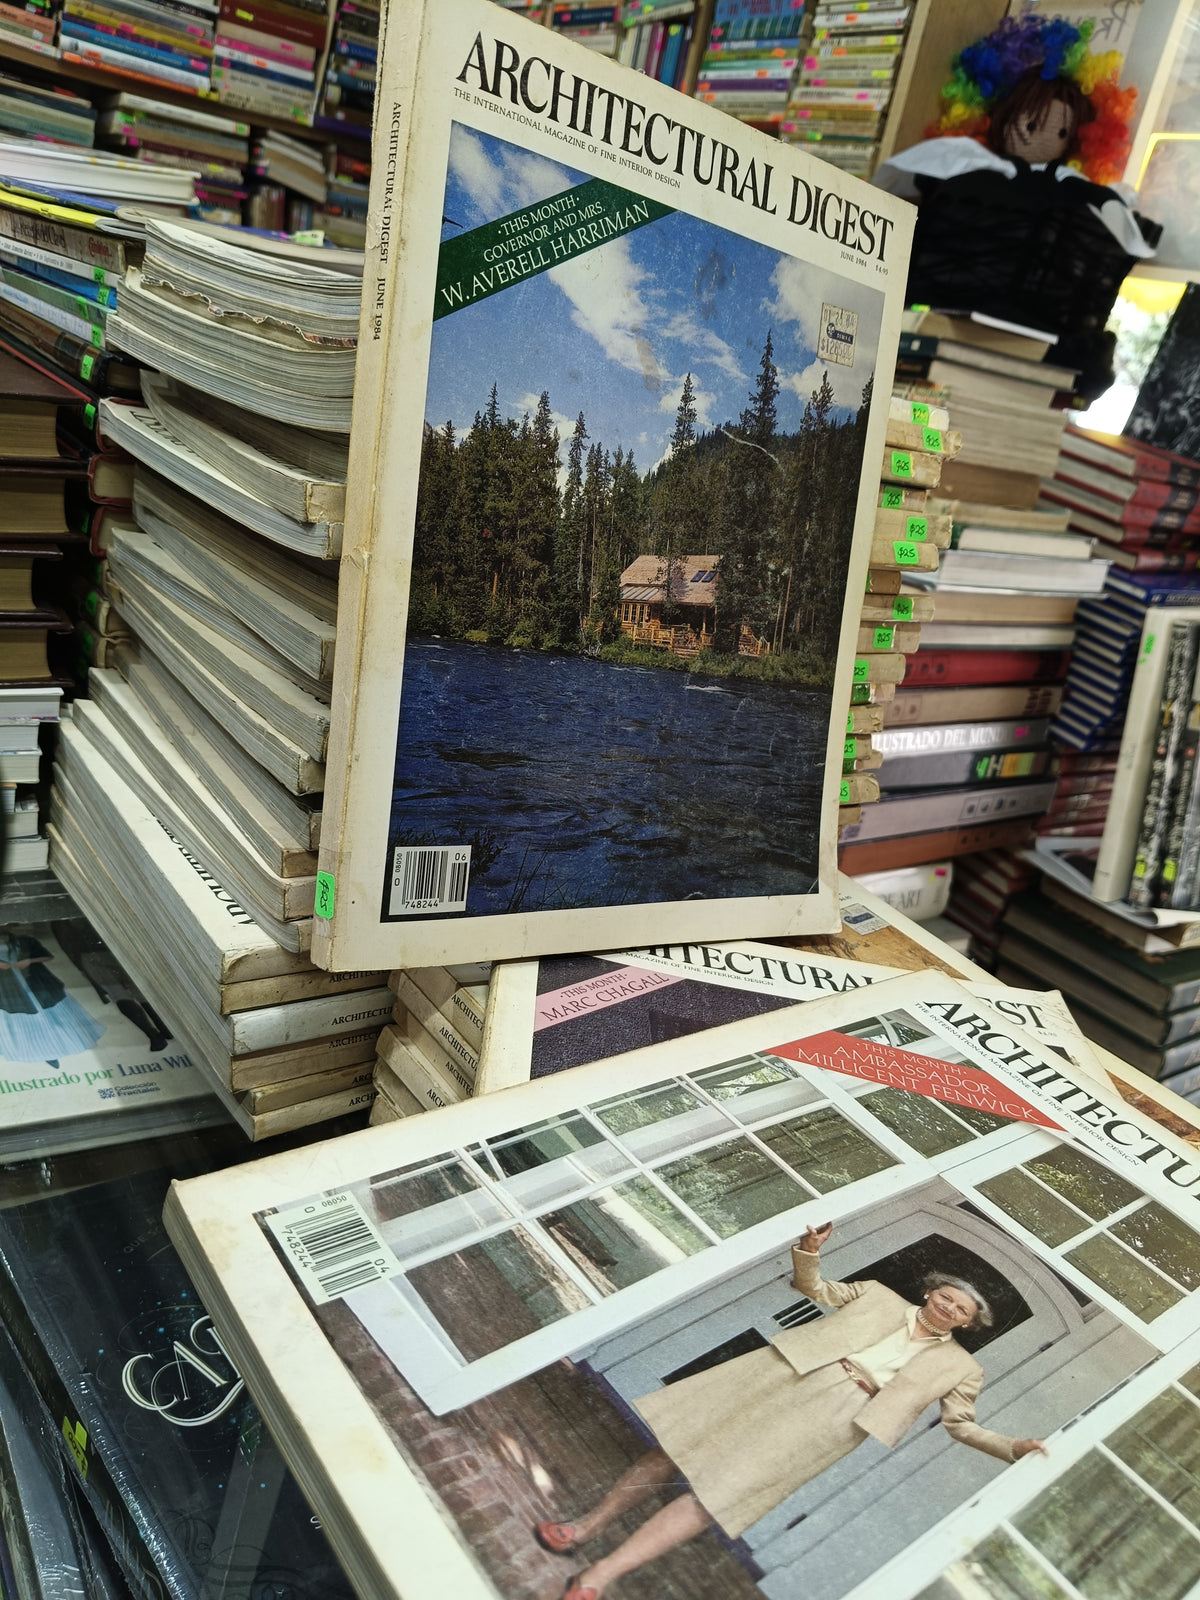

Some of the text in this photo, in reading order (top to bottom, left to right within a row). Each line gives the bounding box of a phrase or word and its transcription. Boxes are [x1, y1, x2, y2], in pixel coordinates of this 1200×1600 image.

[454, 87, 681, 189] THE INTERNATIONAL MAGAZINE OF FINE INTERIOR DESIGN
[456, 31, 894, 262] ARCHITECTURAL DIGEST
[373, 101, 401, 341] ARCHITECTURAL DIGEST JUNE 1984
[483, 201, 606, 263] GOVERNOR AND MRS.
[441, 200, 650, 307] W. AVERELL HARRIMAN
[897, 546, 916, 559] $25
[909, 523, 925, 537] $25
[943, 728, 966, 746] DEL
[404, 899, 439, 910] 748244
[454, 852, 467, 861] 06
[540, 972, 670, 1021] MARC CHAGALL
[83, 1068, 114, 1085] por
[116, 1063, 163, 1077] Luna
[439, 1026, 479, 1072] ARCHITECTU
[834, 1046, 997, 1098] AMBASSADOR
[797, 1048, 1040, 1122] MILLICENT FENWICK
[914, 1002, 1140, 1166] THE INTERNATIONAL MAGAZINE OF FINE INTERIOR DESIGN
[923, 1001, 1200, 1201] ARCHITECTU
[321, 1194, 348, 1208] 08050
[281, 1228, 313, 1268] 748244
[374, 1258, 390, 1273] 04
